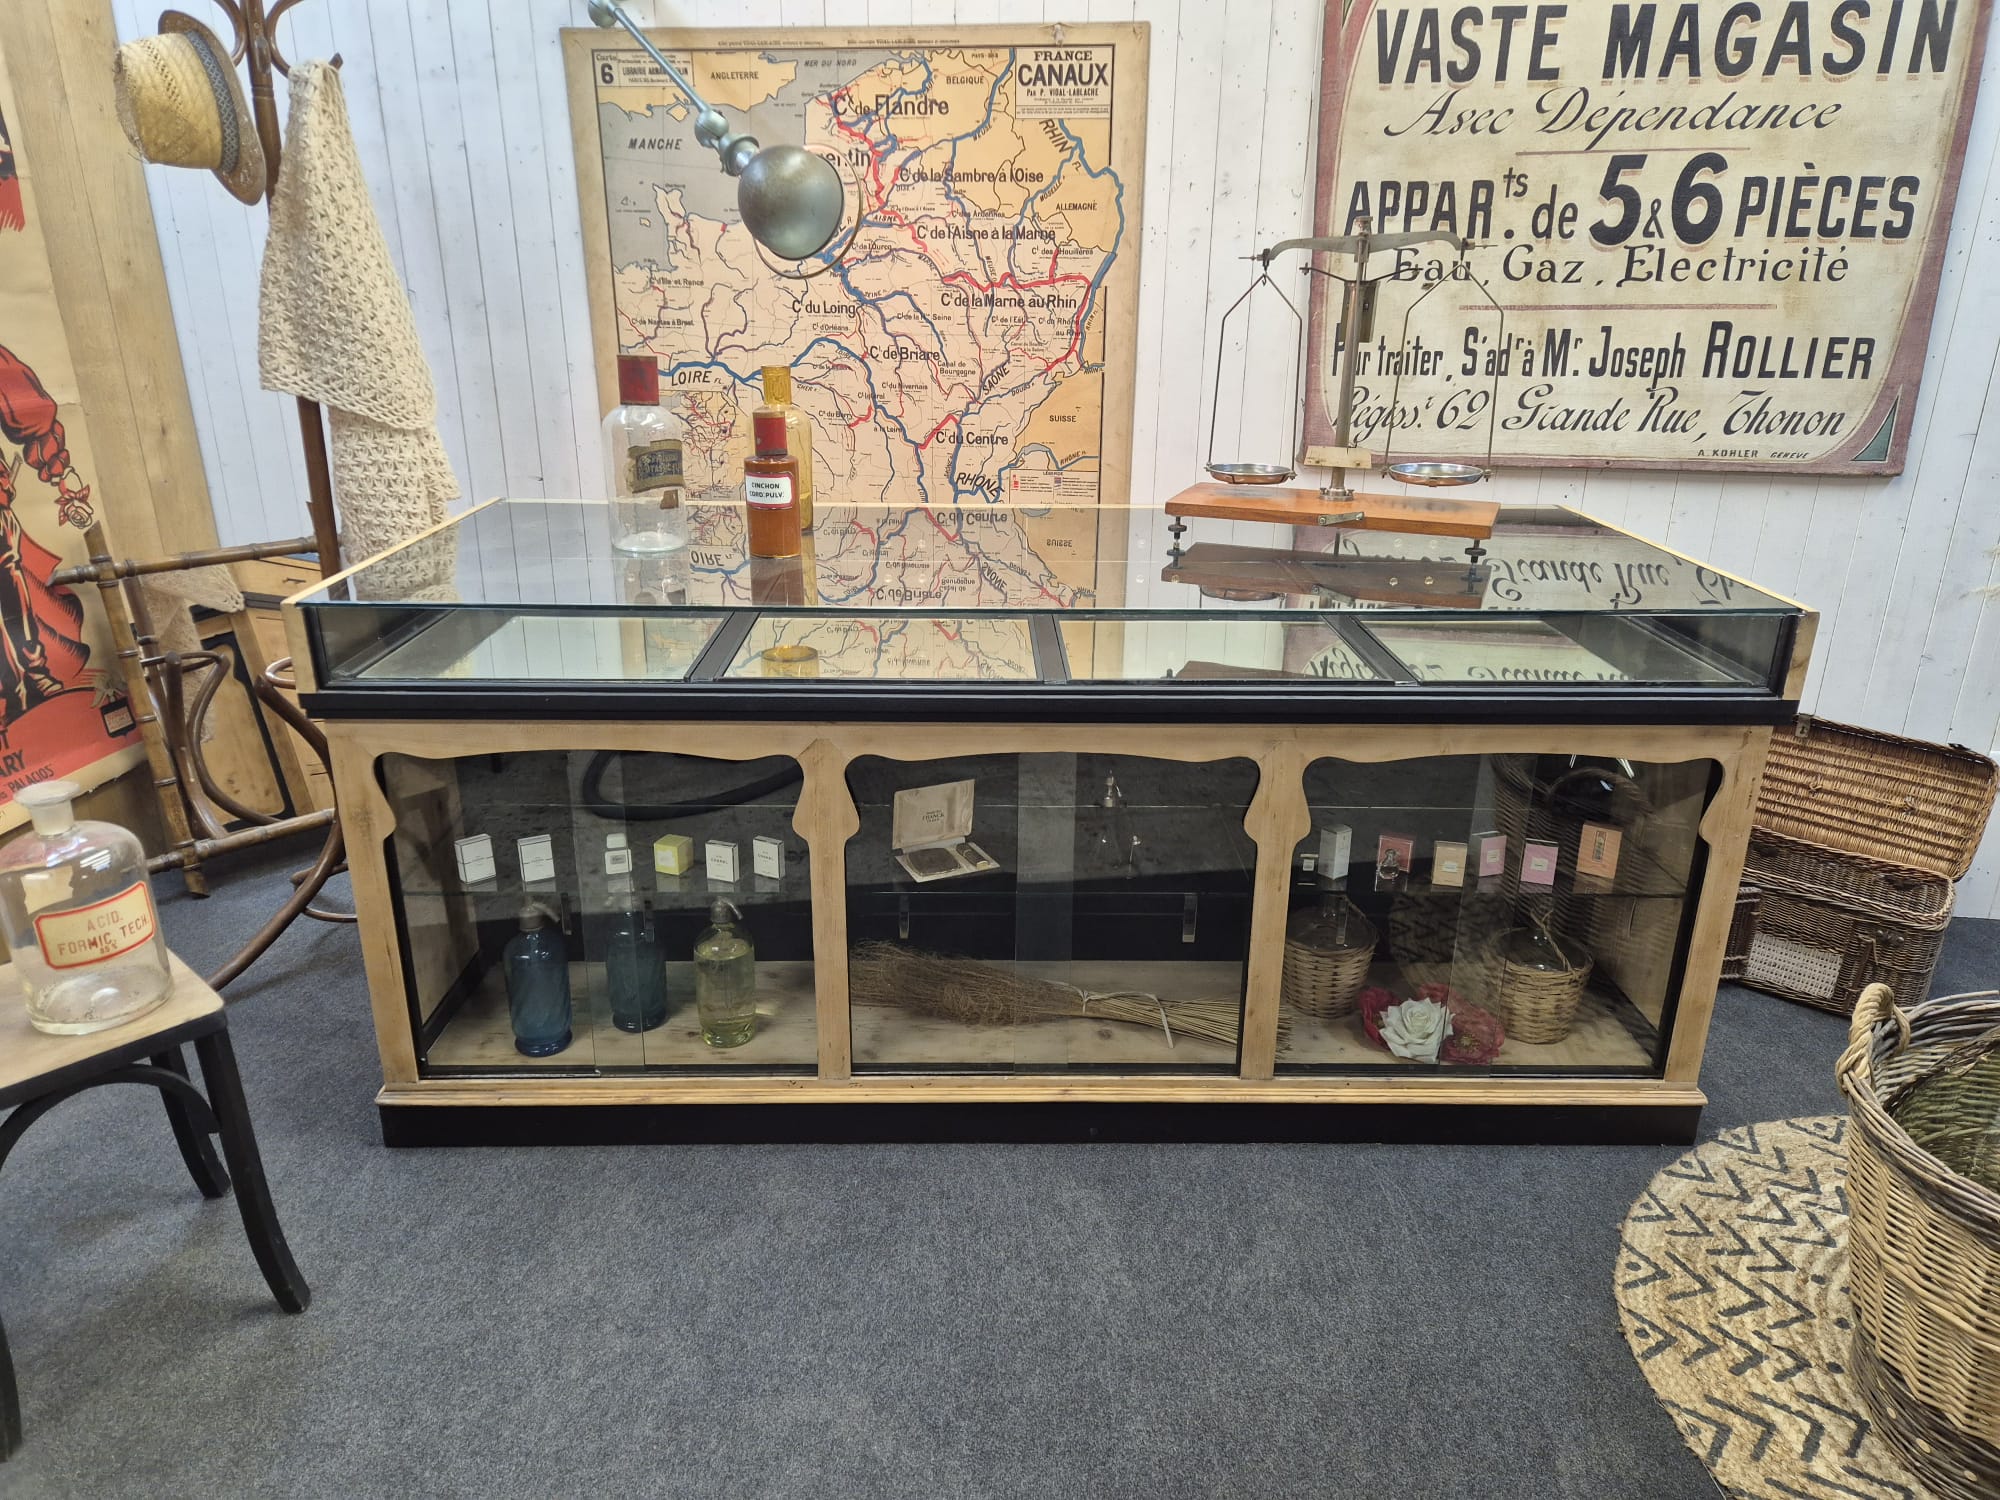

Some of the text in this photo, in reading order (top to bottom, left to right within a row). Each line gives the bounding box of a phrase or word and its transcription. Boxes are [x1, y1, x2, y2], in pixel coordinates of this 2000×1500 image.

[1375, 0, 1960, 84] VASTE MAGASIN
[821, 59, 832, 67] DU
[1034, 50, 1093, 61] FRANCE
[601, 62, 615, 85] 6
[710, 70, 760, 81] ANGLETERRE
[945, 75, 985, 85] BELGIQUE
[1018, 63, 1109, 87] CANAUX
[855, 93, 950, 116] de Flandre
[1535, 84, 1843, 153] Dépendance
[1039, 118, 1073, 153] RHIN
[627, 137, 684, 151] MANCHE
[913, 168, 928, 182] de
[930, 168, 942, 182] la
[945, 167, 996, 183] Sambre
[998, 167, 1007, 183] à
[1055, 202, 1098, 211] ALLEMAGNE
[1530, 183, 1579, 241] de
[1733, 161, 1921, 240] PIÈCES
[930, 225, 946, 240] de
[991, 226, 1000, 240] à
[1002, 225, 1014, 240] la
[1015, 225, 1056, 241] Marne
[1615, 243, 1850, 288] Electricité
[954, 294, 970, 307] de
[971, 294, 983, 307] la
[983, 294, 1026, 308] Marne
[1027, 297, 1046, 309] au
[1046, 293, 1078, 309] Rhin
[806, 300, 821, 314] du
[823, 300, 858, 319] Loing
[932, 313, 952, 321] Seine
[882, 345, 898, 360] de
[899, 345, 940, 361] Briare
[1588, 325, 1687, 392] Joseph
[1701, 320, 1876, 381] ROLLIER
[957, 360, 967, 368] de
[671, 370, 713, 387] LOIRE
[939, 367, 977, 378] Bourgogne
[1049, 414, 1077, 423] SUISSE
[1436, 387, 1490, 431] 62
[1722, 388, 1848, 437] Thonon
[949, 431, 964, 445] du
[966, 432, 1009, 446] Centre
